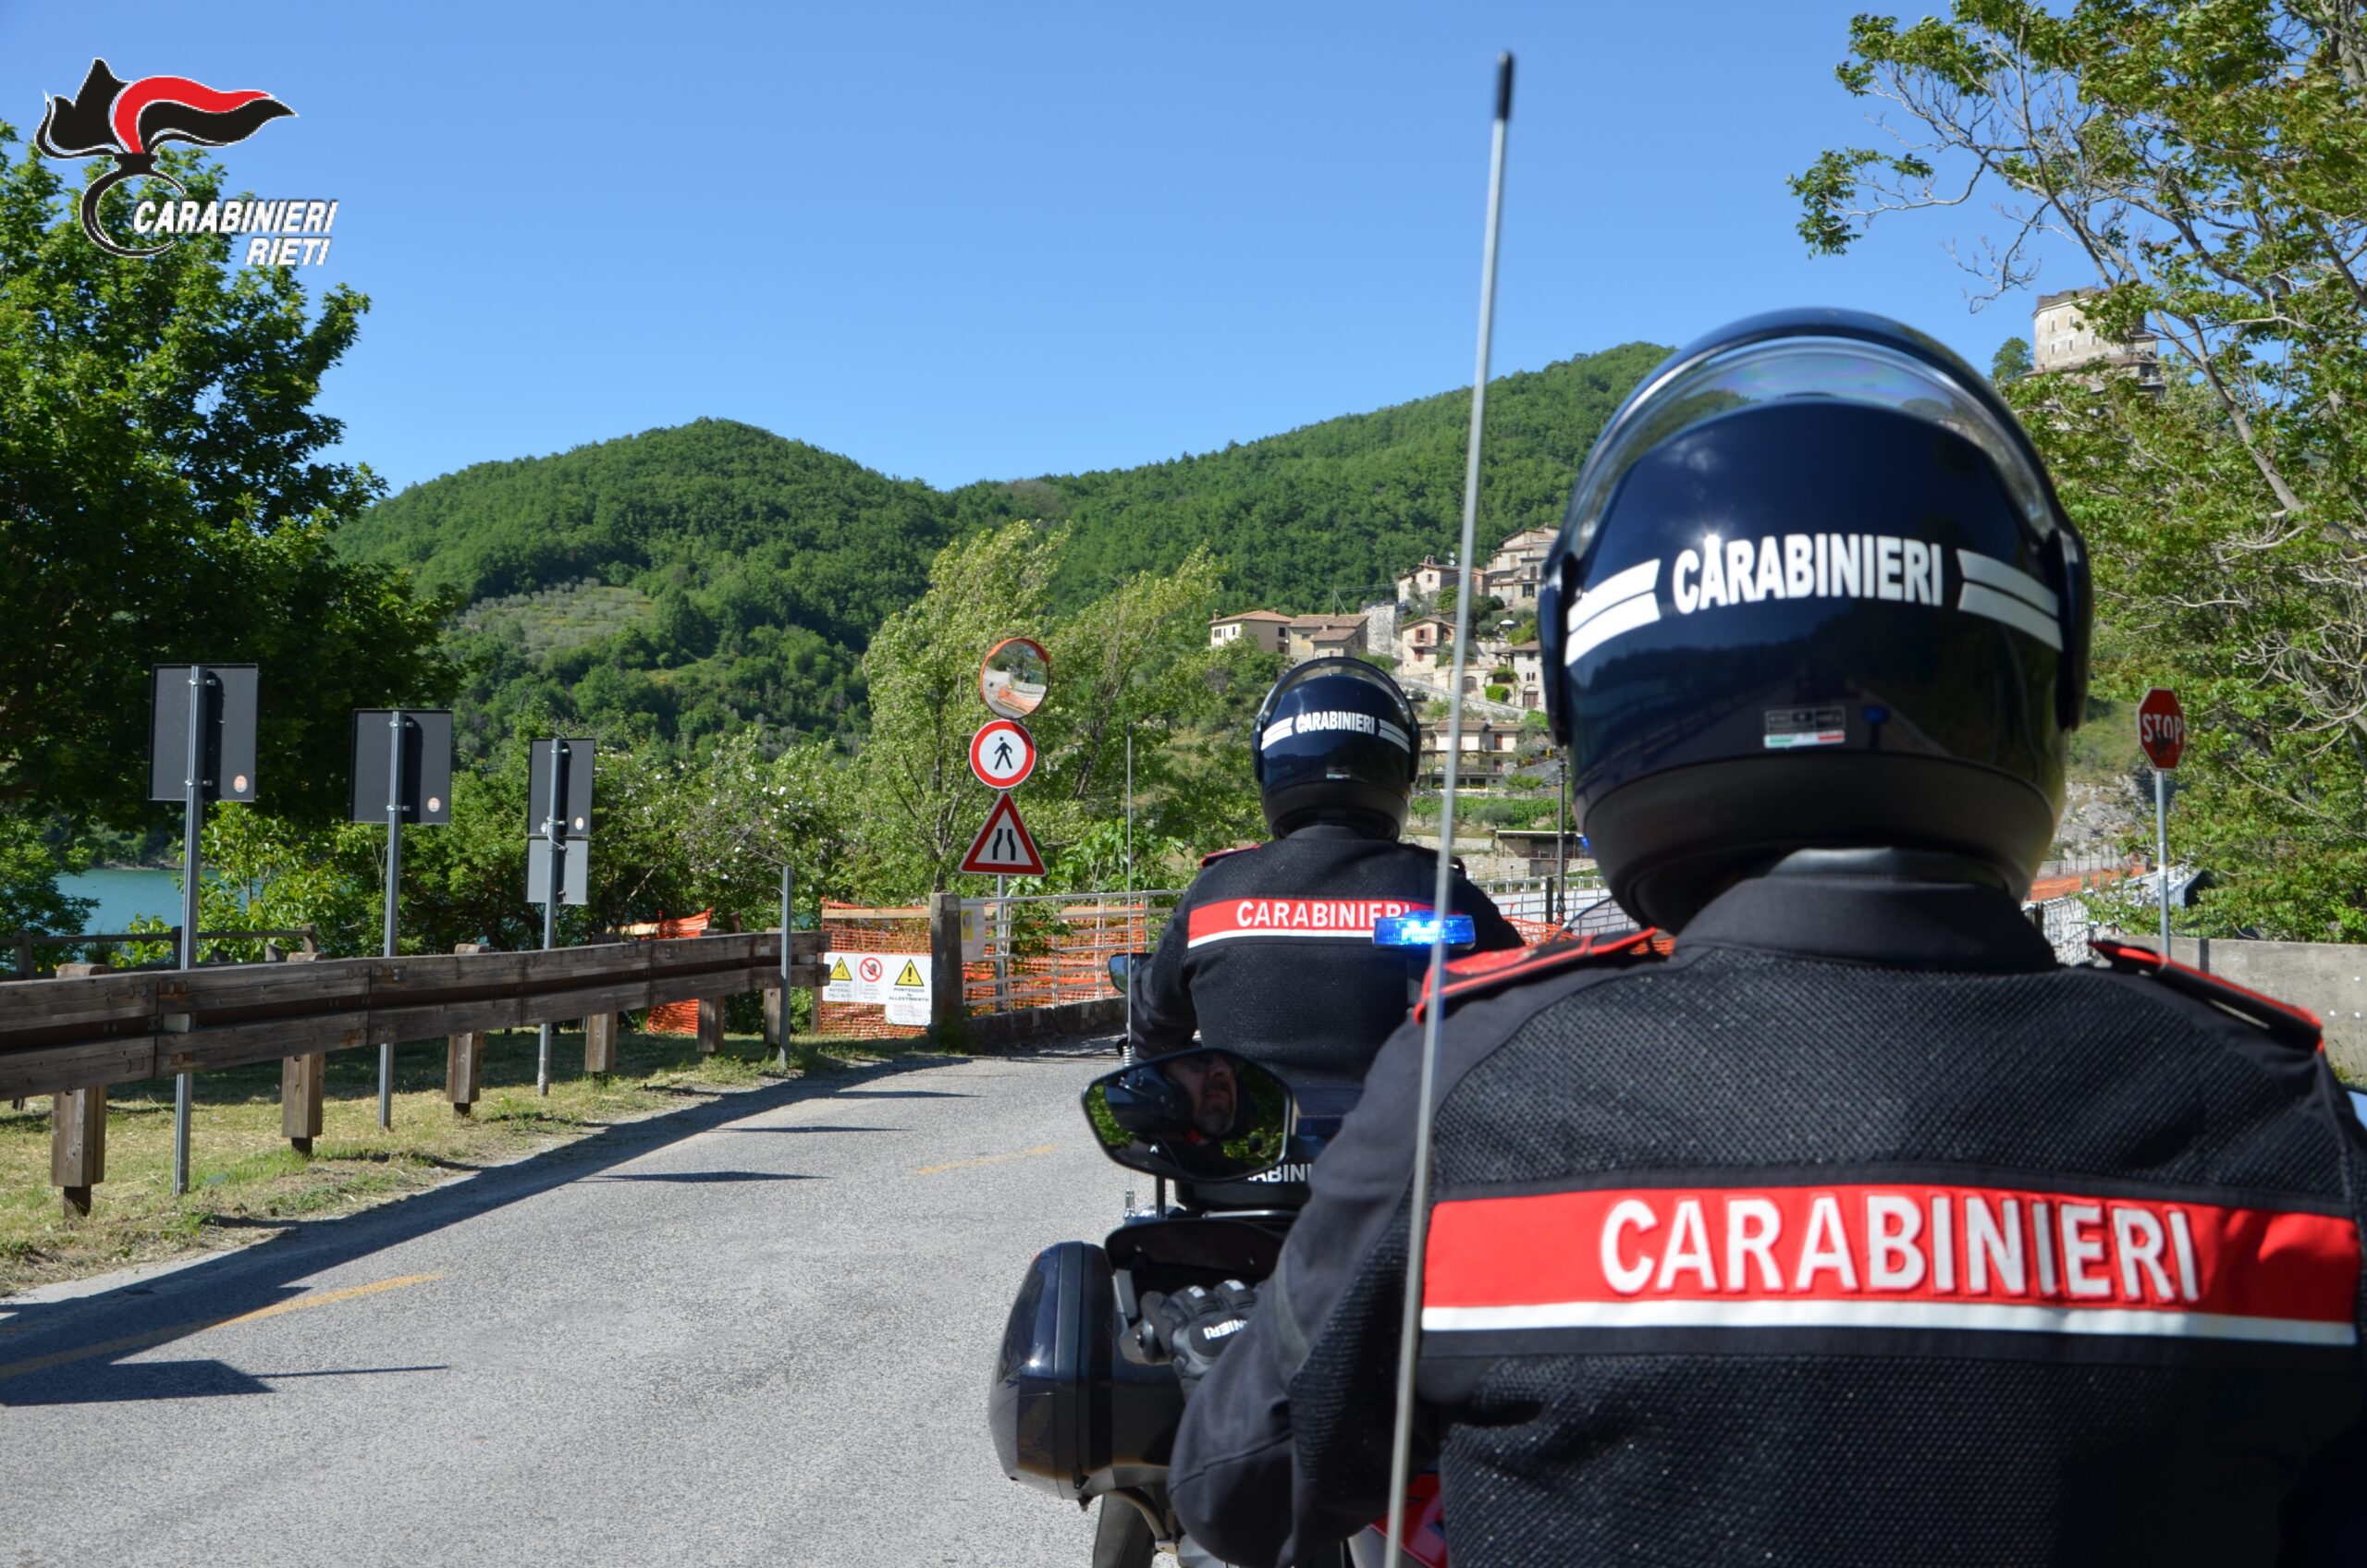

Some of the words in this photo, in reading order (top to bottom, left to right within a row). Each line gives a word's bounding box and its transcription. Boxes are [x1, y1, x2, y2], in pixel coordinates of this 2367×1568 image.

[1672, 533, 1943, 615] CARABINIERI
[1295, 711, 1375, 735] CARABINIERI
[2142, 713, 2182, 745] STOP
[1600, 1194, 2199, 1302] CARABINIERI
